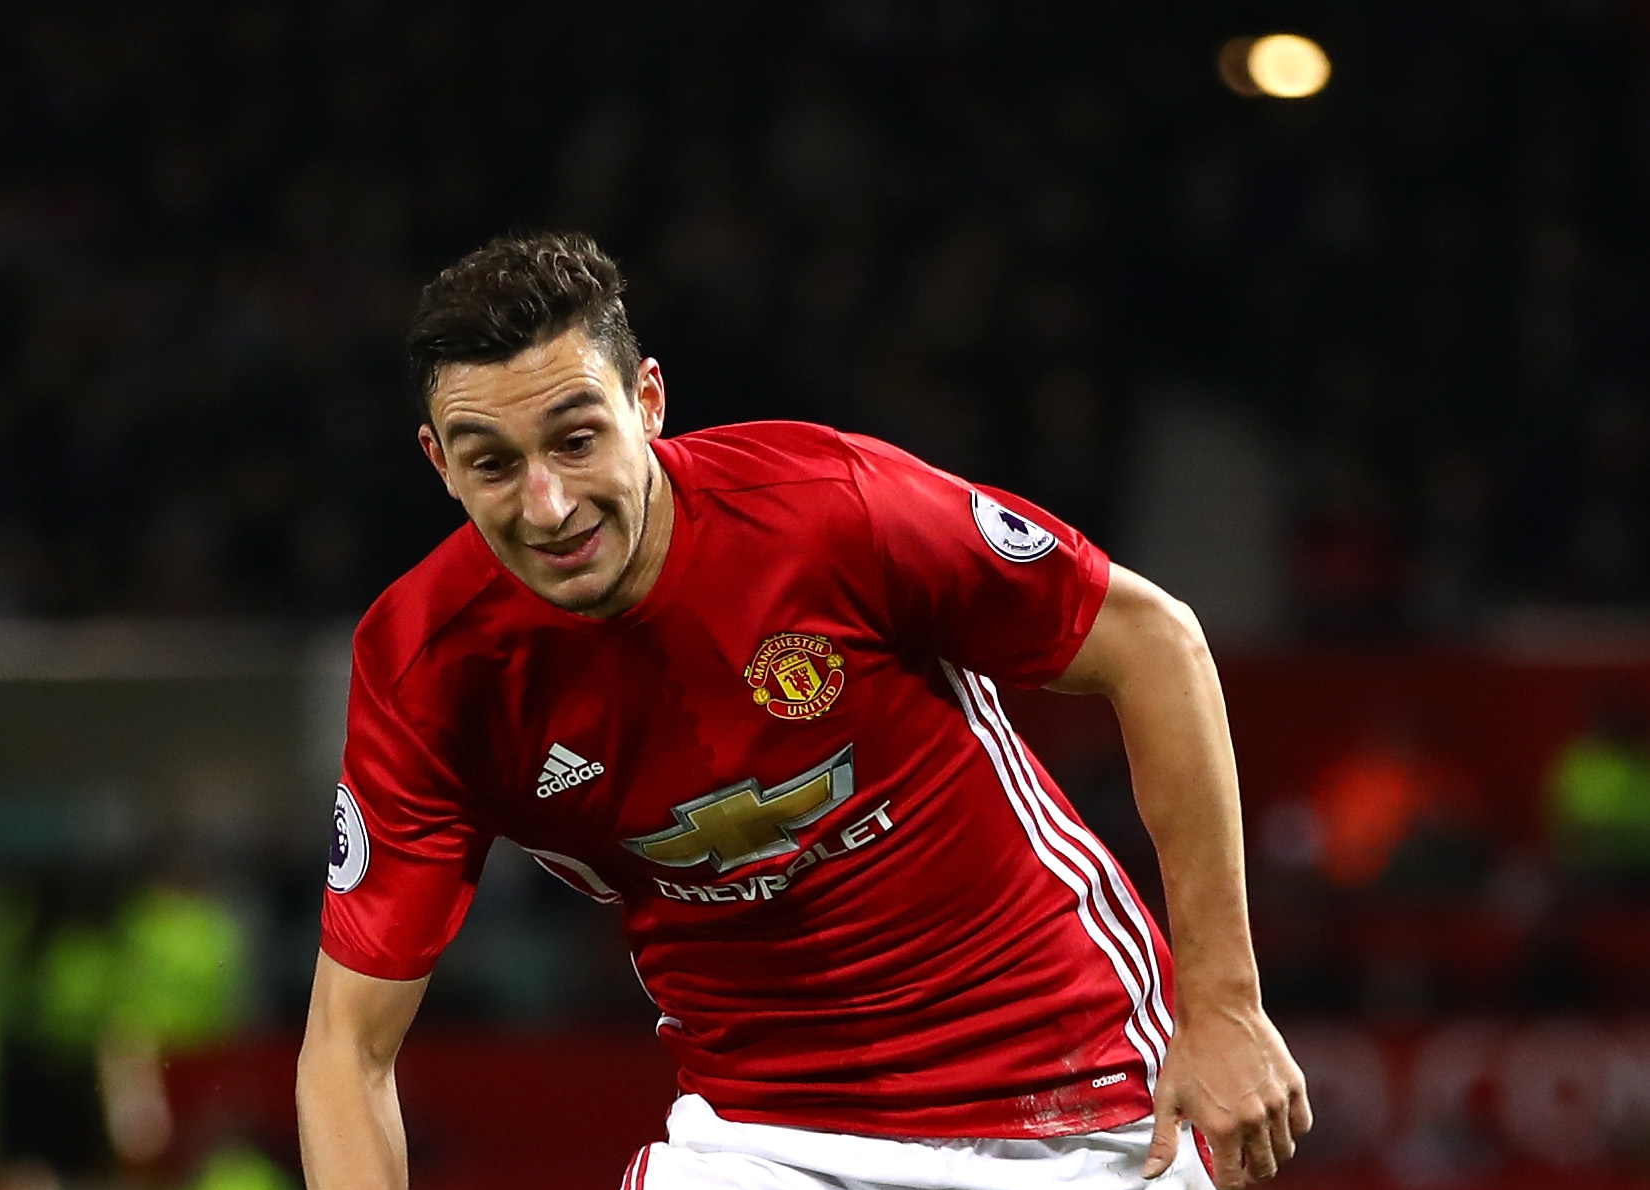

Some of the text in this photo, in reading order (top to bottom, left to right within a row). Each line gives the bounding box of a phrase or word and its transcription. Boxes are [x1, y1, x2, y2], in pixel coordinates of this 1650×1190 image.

[753, 637, 825, 681] MANCHESTER
[787, 684, 837, 716] UNITED
[536, 761, 605, 799] adidas
[652, 799, 894, 902] CHEVROLET
[1092, 1072, 1127, 1088] adizero
